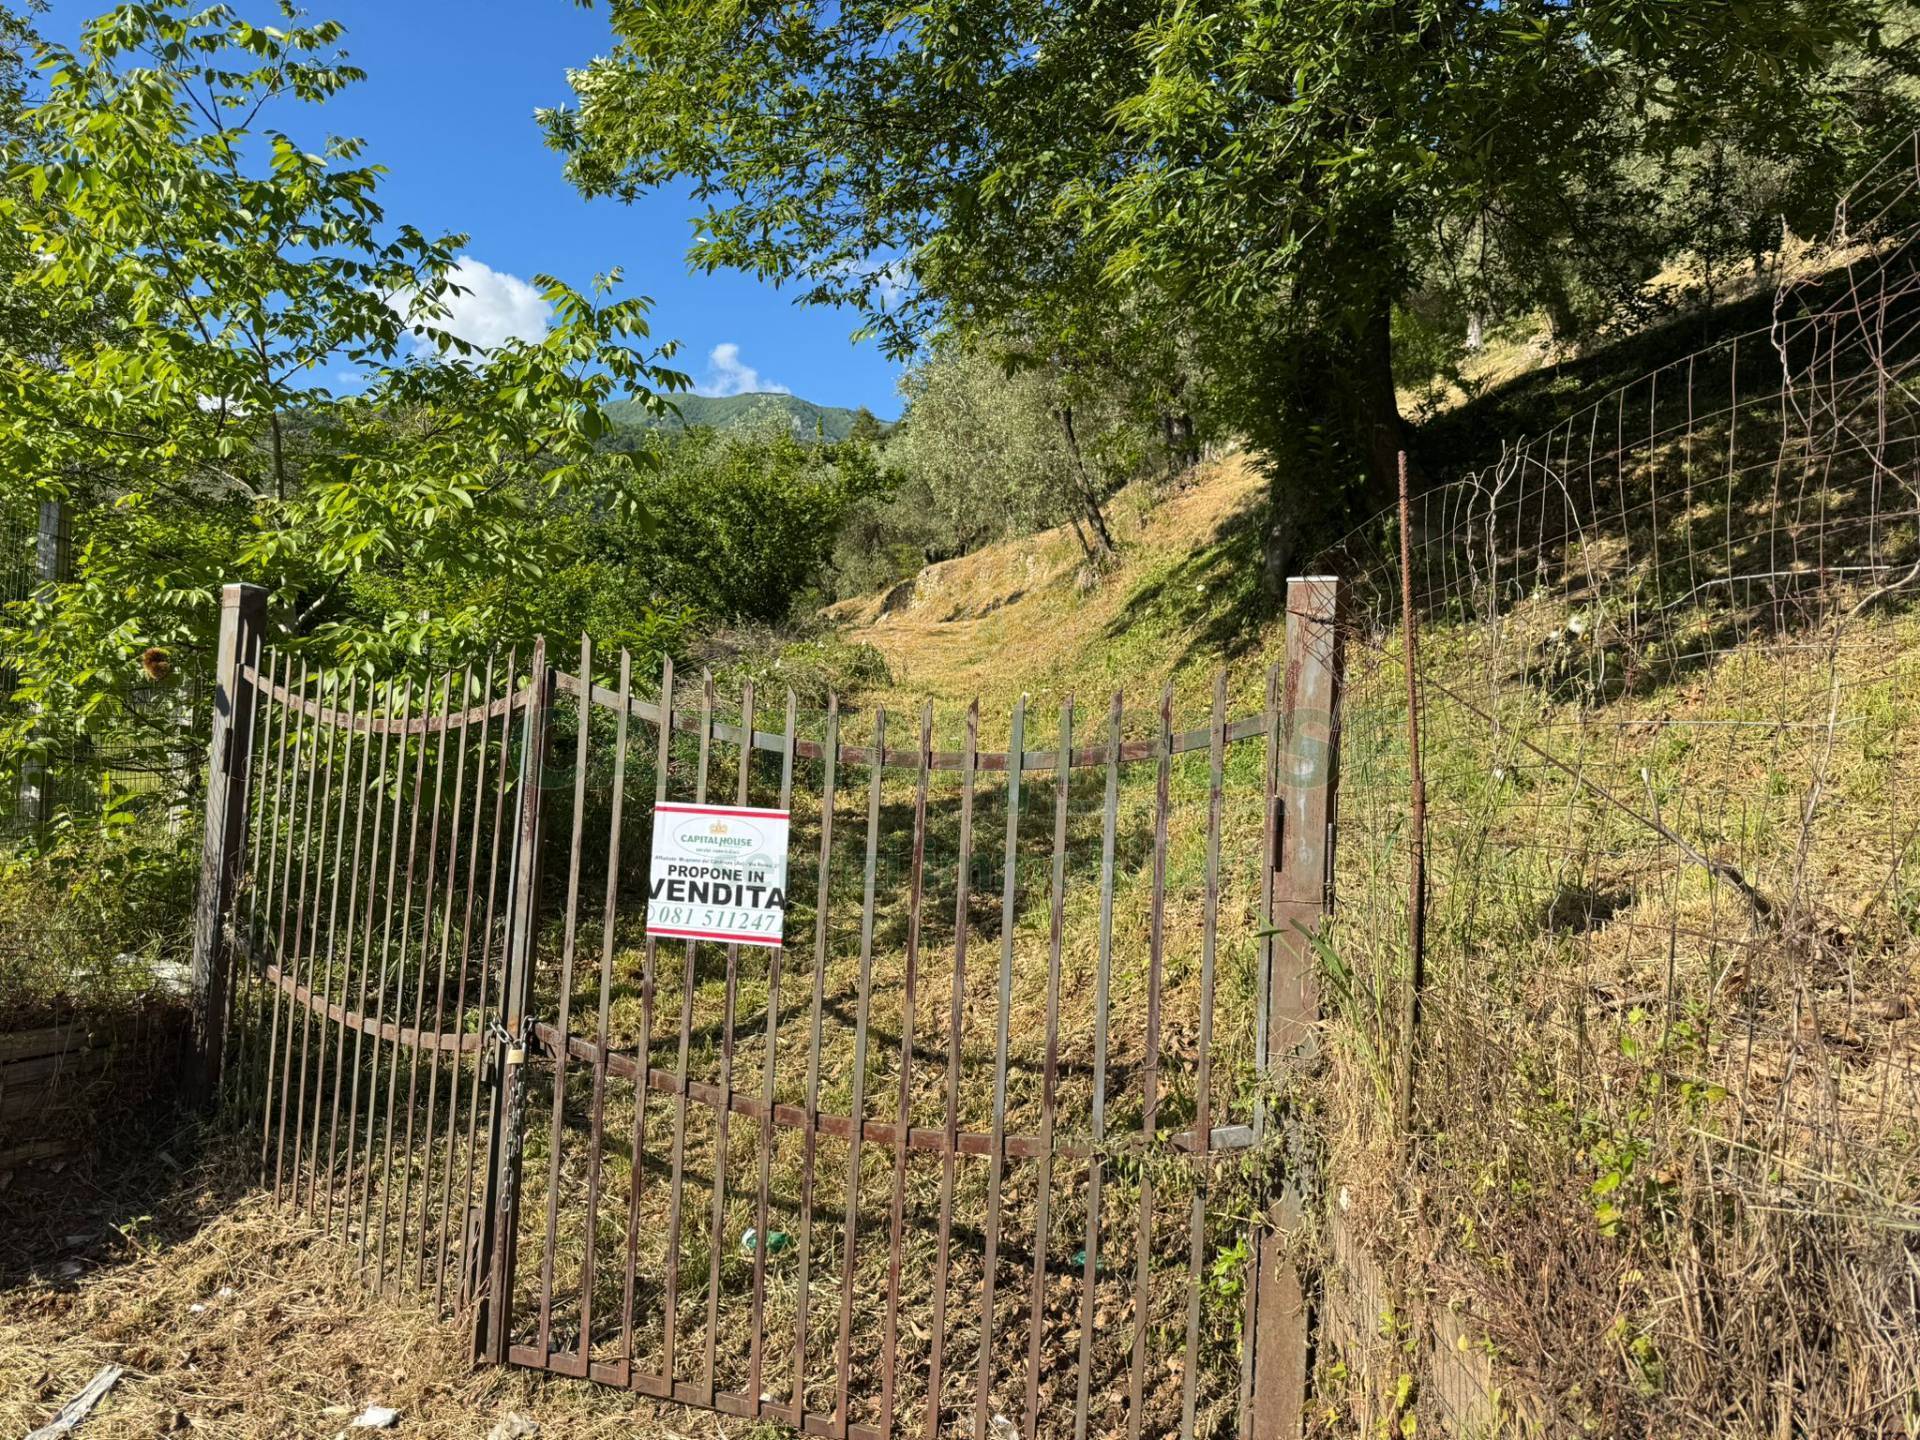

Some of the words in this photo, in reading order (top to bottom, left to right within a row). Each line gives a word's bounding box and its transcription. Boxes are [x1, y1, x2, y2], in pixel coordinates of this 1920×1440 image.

[681, 833, 753, 847] CAPITALHOUSE
[668, 864, 743, 882] PROPONE
[748, 870, 765, 883] IN
[648, 878, 785, 911] VENDITA
[659, 905, 694, 925] 081
[701, 909, 783, 932] 511247
